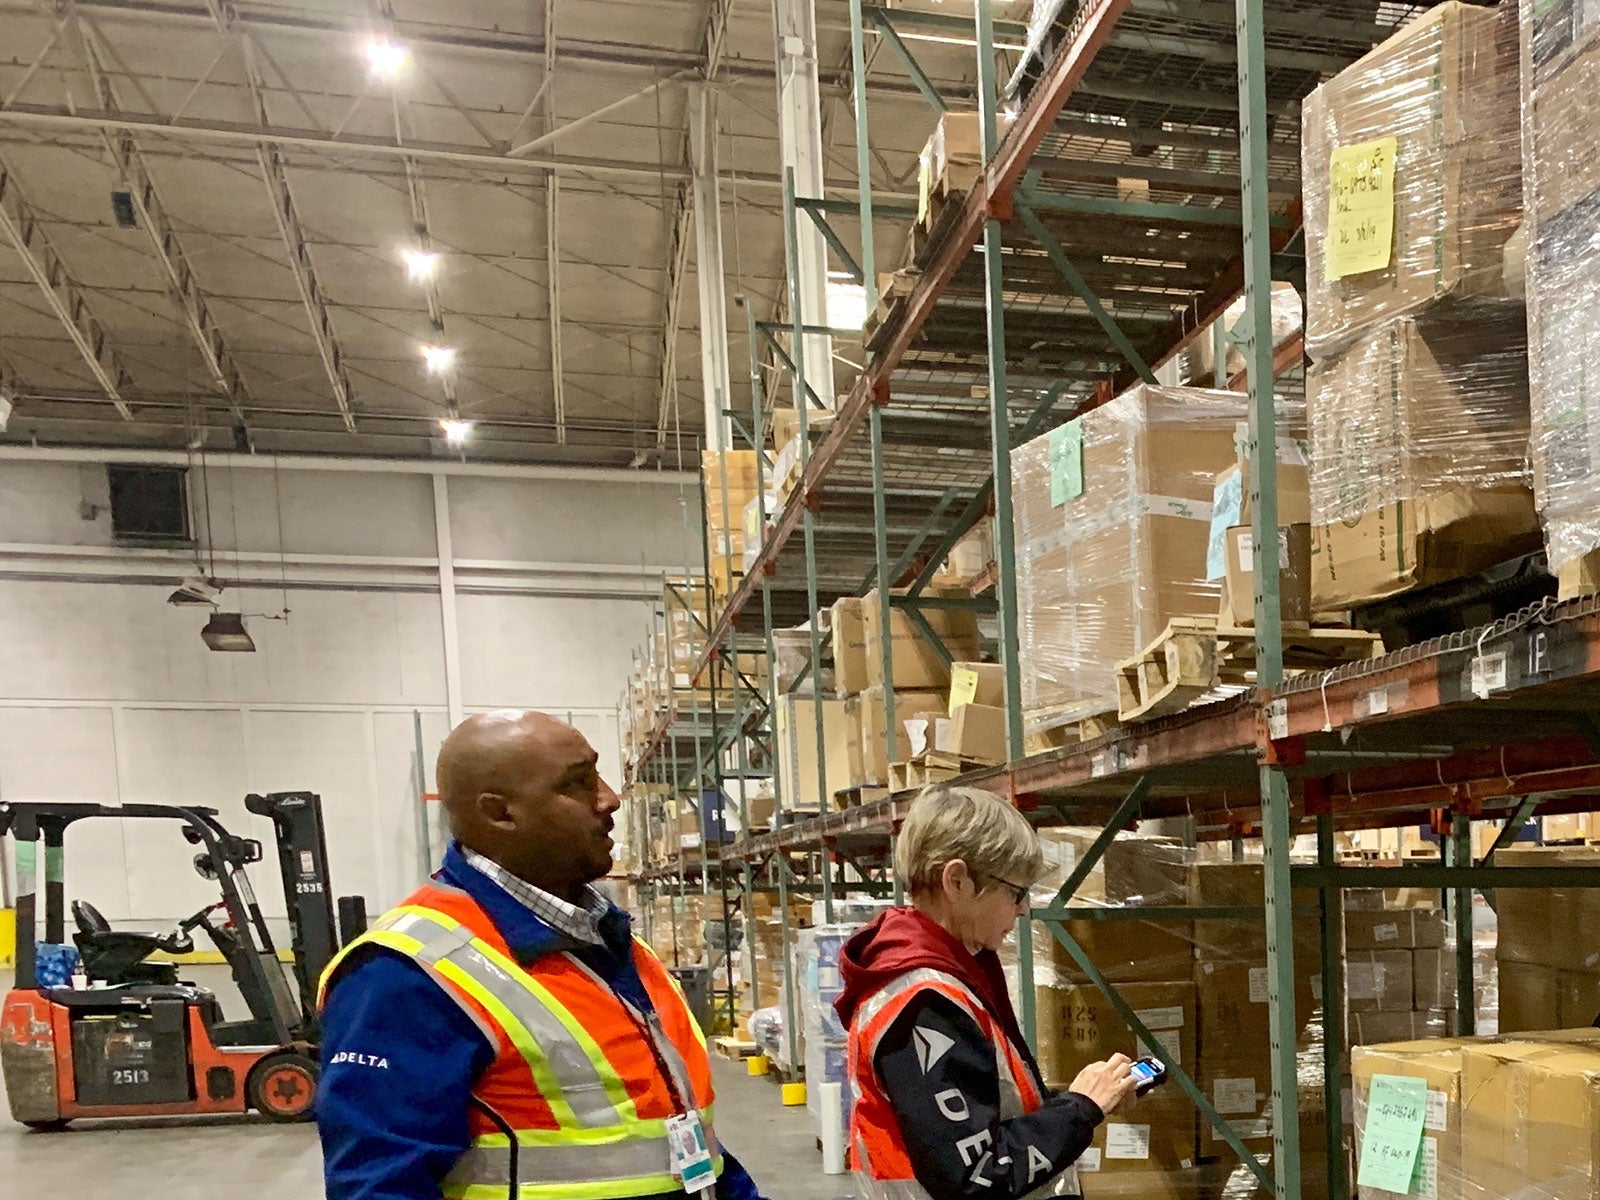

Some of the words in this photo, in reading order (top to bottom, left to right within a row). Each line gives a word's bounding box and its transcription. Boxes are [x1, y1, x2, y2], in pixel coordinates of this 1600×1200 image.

[295, 882, 323, 894] 2535
[339, 1051, 389, 1070] DELTA
[112, 1069, 150, 1085] 2513
[934, 1088, 1053, 1188] DELA
